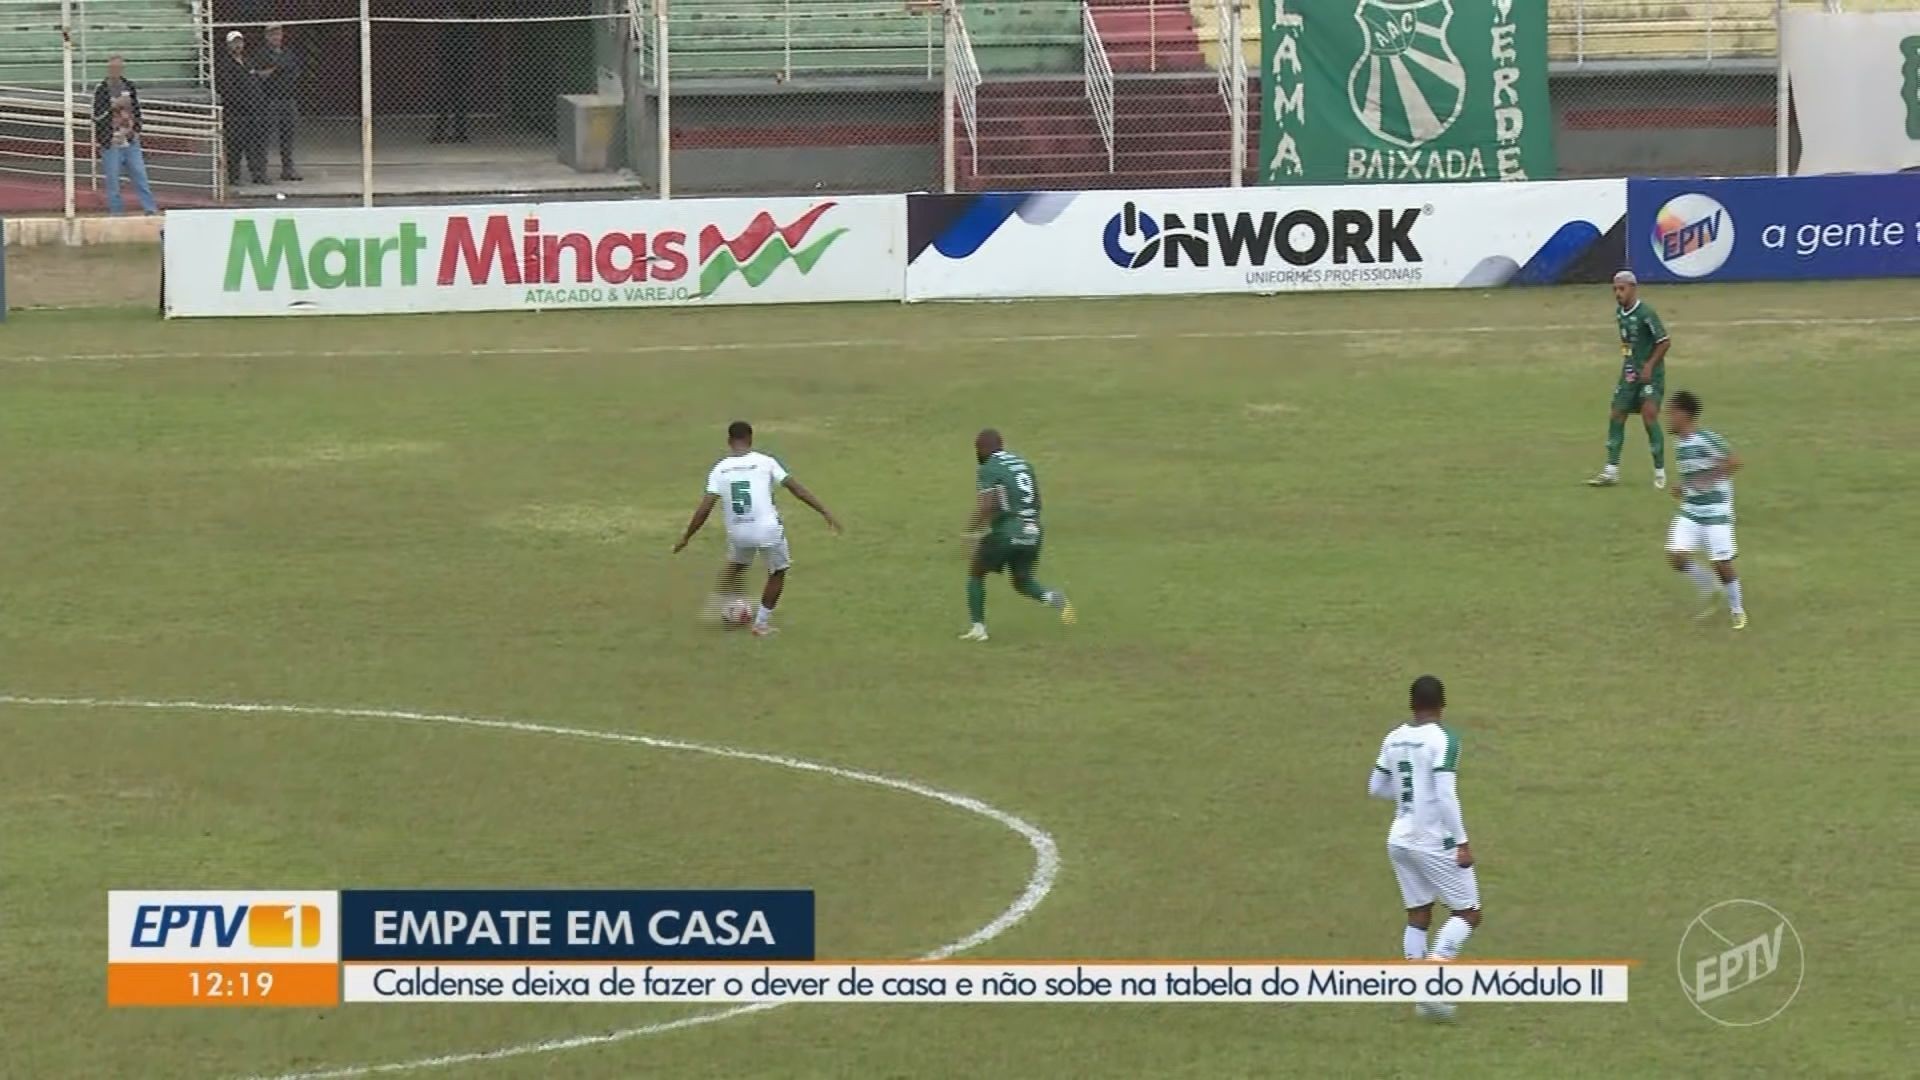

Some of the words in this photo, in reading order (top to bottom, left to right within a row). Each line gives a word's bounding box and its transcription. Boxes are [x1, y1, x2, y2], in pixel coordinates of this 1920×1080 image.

[1374, 11, 1414, 48] AAC
[1270, 0, 1304, 180] LAMA
[223, 218, 427, 292] Mart
[437, 213, 689, 286] Minas
[1103, 201, 1424, 269] ONWORK
[1663, 208, 1722, 262] EPTV
[1762, 224, 1786, 248] a
[1796, 216, 1905, 255] gente
[525, 289, 602, 304] ATACADO
[607, 287, 618, 302] &
[624, 286, 689, 301] VAREJO
[1246, 269, 1321, 284] UNIFORMES
[1324, 267, 1423, 282] PROFISSIONAIS
[730, 480, 752, 515] 5
[1015, 472, 1035, 504] 9
[1397, 761, 1415, 803] 3
